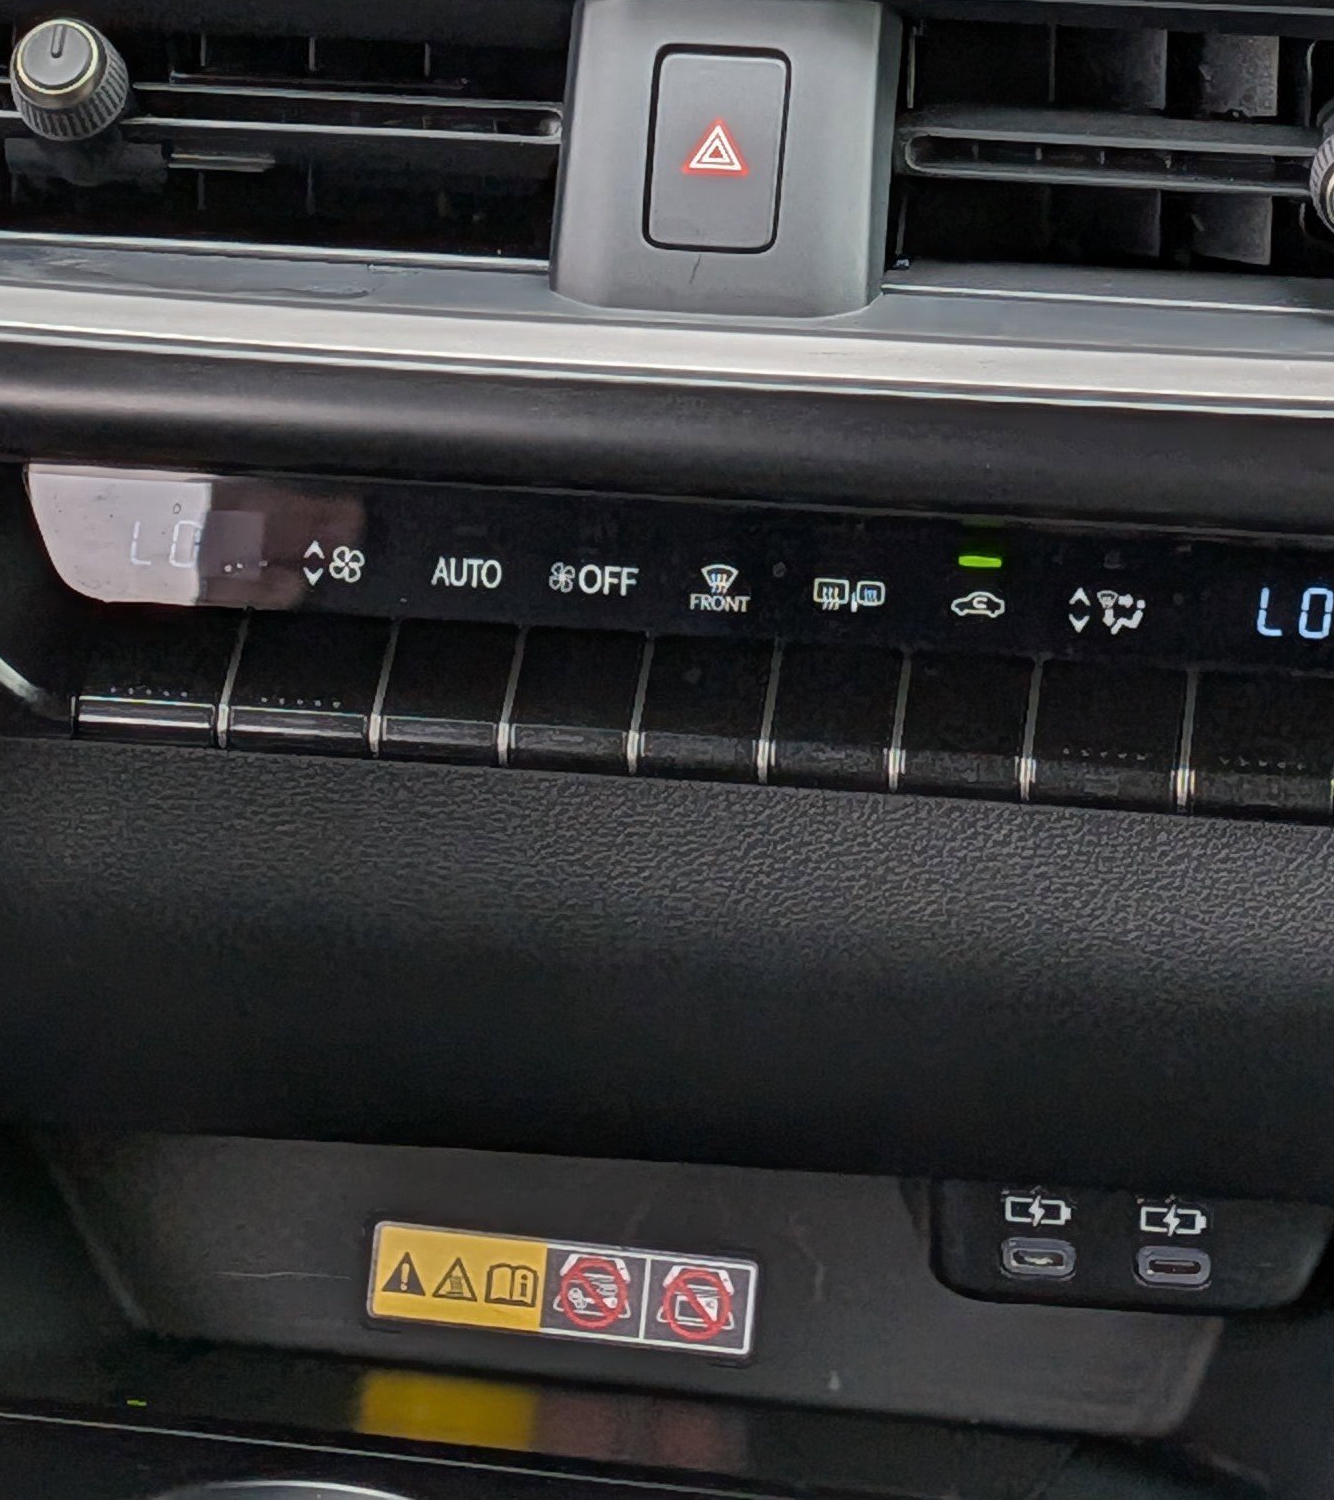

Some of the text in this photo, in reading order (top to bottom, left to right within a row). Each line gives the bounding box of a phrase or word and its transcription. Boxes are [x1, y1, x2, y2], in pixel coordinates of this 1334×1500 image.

[432, 558, 503, 589] AUTO
[578, 565, 639, 596] OFF
[689, 593, 750, 613] FRONT
